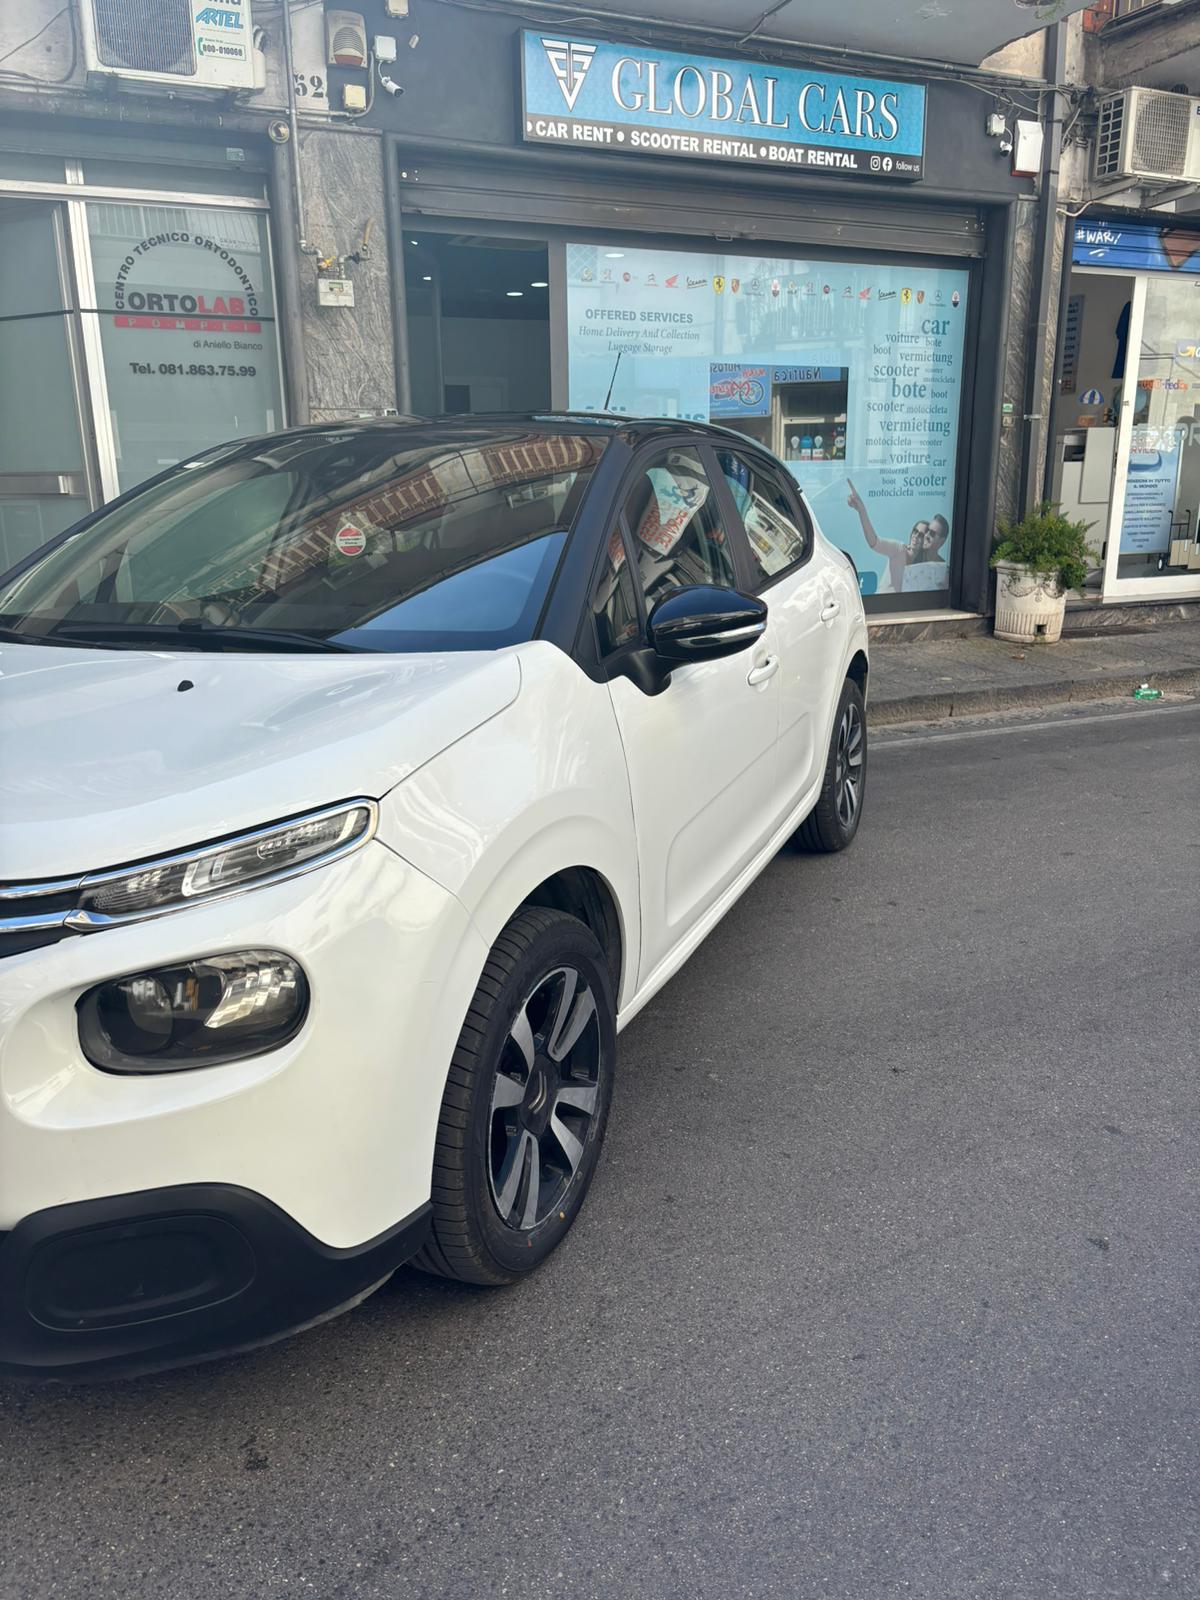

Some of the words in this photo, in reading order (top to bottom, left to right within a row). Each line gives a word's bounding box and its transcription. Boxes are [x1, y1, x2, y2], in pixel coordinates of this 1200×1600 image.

[195, 7, 244, 29] ARTEL
[611, 56, 790, 129] GLOBAL
[798, 81, 899, 142] CARS
[535, 120, 568, 139] CAR
[572, 125, 613, 143] RENT
[631, 131, 699, 152] SCOOTER
[703, 139, 757, 158] RENTAL
[769, 146, 804, 163] BOAT
[808, 150, 858, 169] RENTAL
[895, 160, 912, 171] follow
[913, 164, 920, 172] us
[115, 256, 135, 310] CENTRO
[133, 232, 190, 256] TECNICO
[195, 236, 258, 316] ORTODONTICO
[128, 292, 245, 315] ORTOLAB
[585, 309, 636, 321] OFFERED
[640, 311, 693, 323] SERVICES
[579, 326, 604, 336] Home
[605, 327, 640, 341] Delivery
[641, 328, 659, 339] And
[660, 329, 700, 341] Collection
[921, 319, 950, 335] car
[193, 340, 201, 349] di
[203, 340, 232, 349] Aniello
[234, 341, 263, 350] Bianco
[885, 331, 920, 343] voiture
[925, 336, 942, 347] bote
[608, 341, 641, 353] Luggage
[643, 342, 673, 353] Storage
[873, 344, 891, 355] boot
[899, 350, 953, 366] vermietung
[130, 362, 155, 375] Tel.
[159, 363, 256, 377] 081.863.75.99
[873, 364, 920, 377] scooter
[891, 377, 927, 398] bote
[930, 389, 948, 399] boot
[866, 401, 905, 412] scooter
[906, 405, 948, 414] motocicleta
[879, 417, 951, 437] vermietung
[865, 435, 912, 446] motocicleta
[889, 450, 931, 464] voiture
[933, 459, 947, 467] car
[903, 473, 947, 487] scooter
[868, 487, 914, 497] motocicleta
